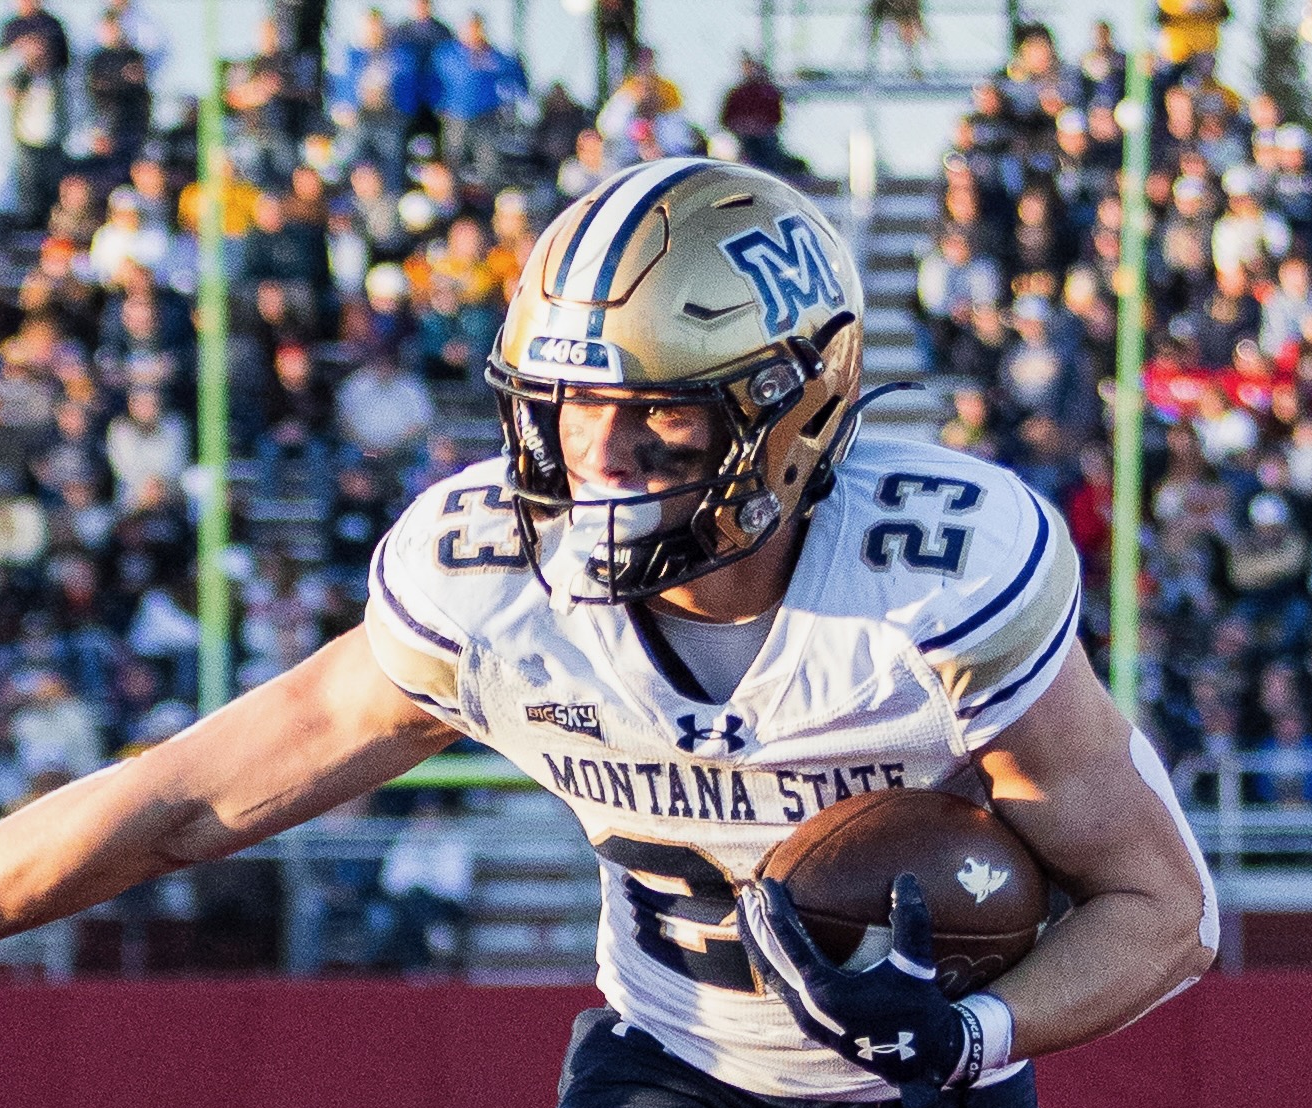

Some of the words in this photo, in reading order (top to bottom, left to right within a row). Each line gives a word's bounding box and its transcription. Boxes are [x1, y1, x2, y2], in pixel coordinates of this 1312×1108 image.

[717, 212, 848, 346] M
[540, 338, 587, 365] 406
[433, 484, 543, 576] 23
[860, 472, 988, 580] 23
[542, 752, 756, 821] MONTANA
[587, 826, 783, 998] 2
